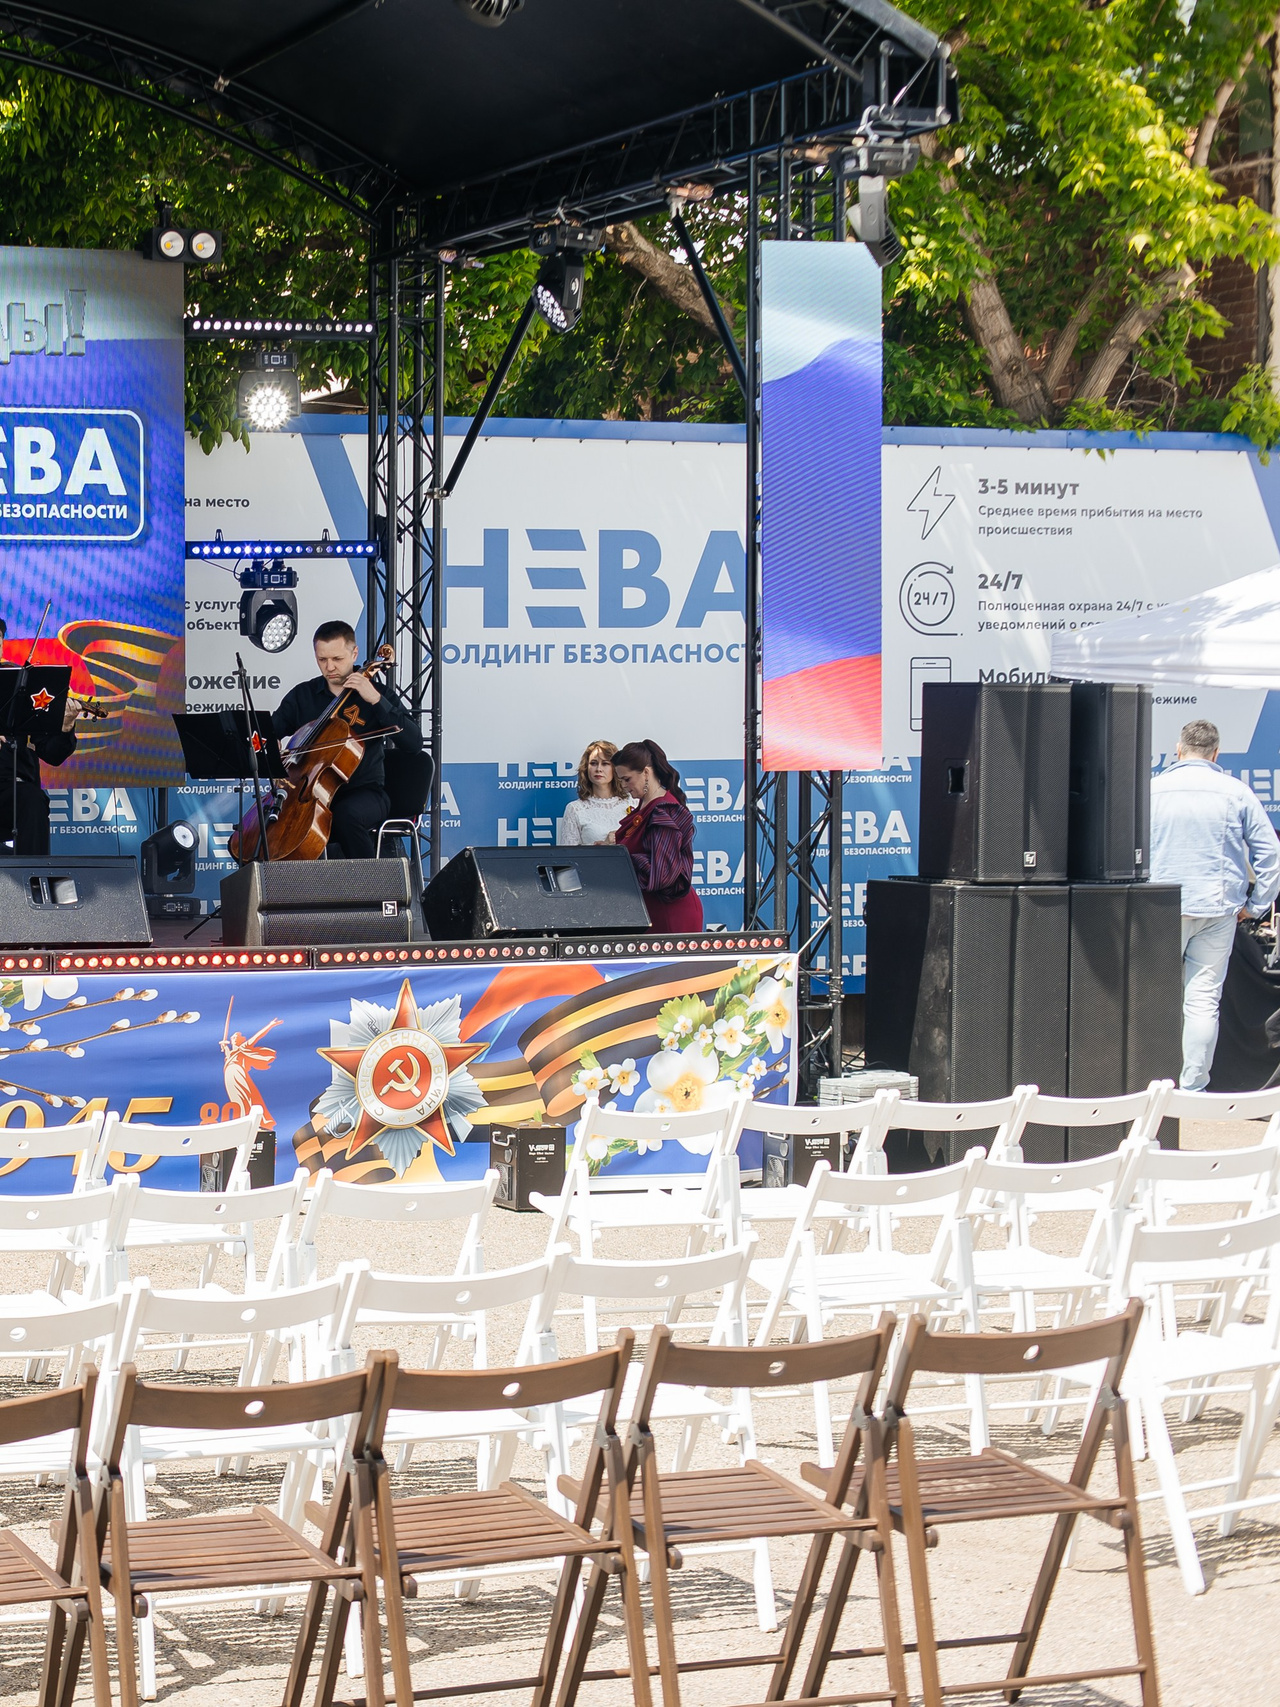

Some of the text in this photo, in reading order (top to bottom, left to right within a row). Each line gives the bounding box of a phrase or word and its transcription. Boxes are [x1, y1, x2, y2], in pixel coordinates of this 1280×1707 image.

[978, 478, 1080, 500] 3-5 минут
[206, 497, 250, 508] место
[978, 505, 1203, 520] Среднее время прибытия на место
[978, 525, 1073, 538] происшествия
[978, 573, 1023, 592] 24/7
[913, 591, 949, 607] 24/7
[978, 600, 1064, 614] Полноценная
[1069, 602, 1113, 614] охрана
[1116, 601, 1144, 612] 24/7
[978, 618, 1066, 634] уведомлений
[1070, 622, 1078, 632] о
[422, 644, 556, 669] ОЛДИНГ
[185, 675, 281, 690] ожение
[498, 780, 579, 791] ХОЛДИНГ БЕЗОПА
[845, 774, 912, 784] БЕЗОПАСНОСТИ
[177, 785, 224, 795] ХОЛДИНГ
[49, 787, 137, 822] ЕВА
[60, 824, 137, 835] БЕЗОПАСНОСТИ
[844, 846, 911, 856] БЕЗОПАСНОСТИ
